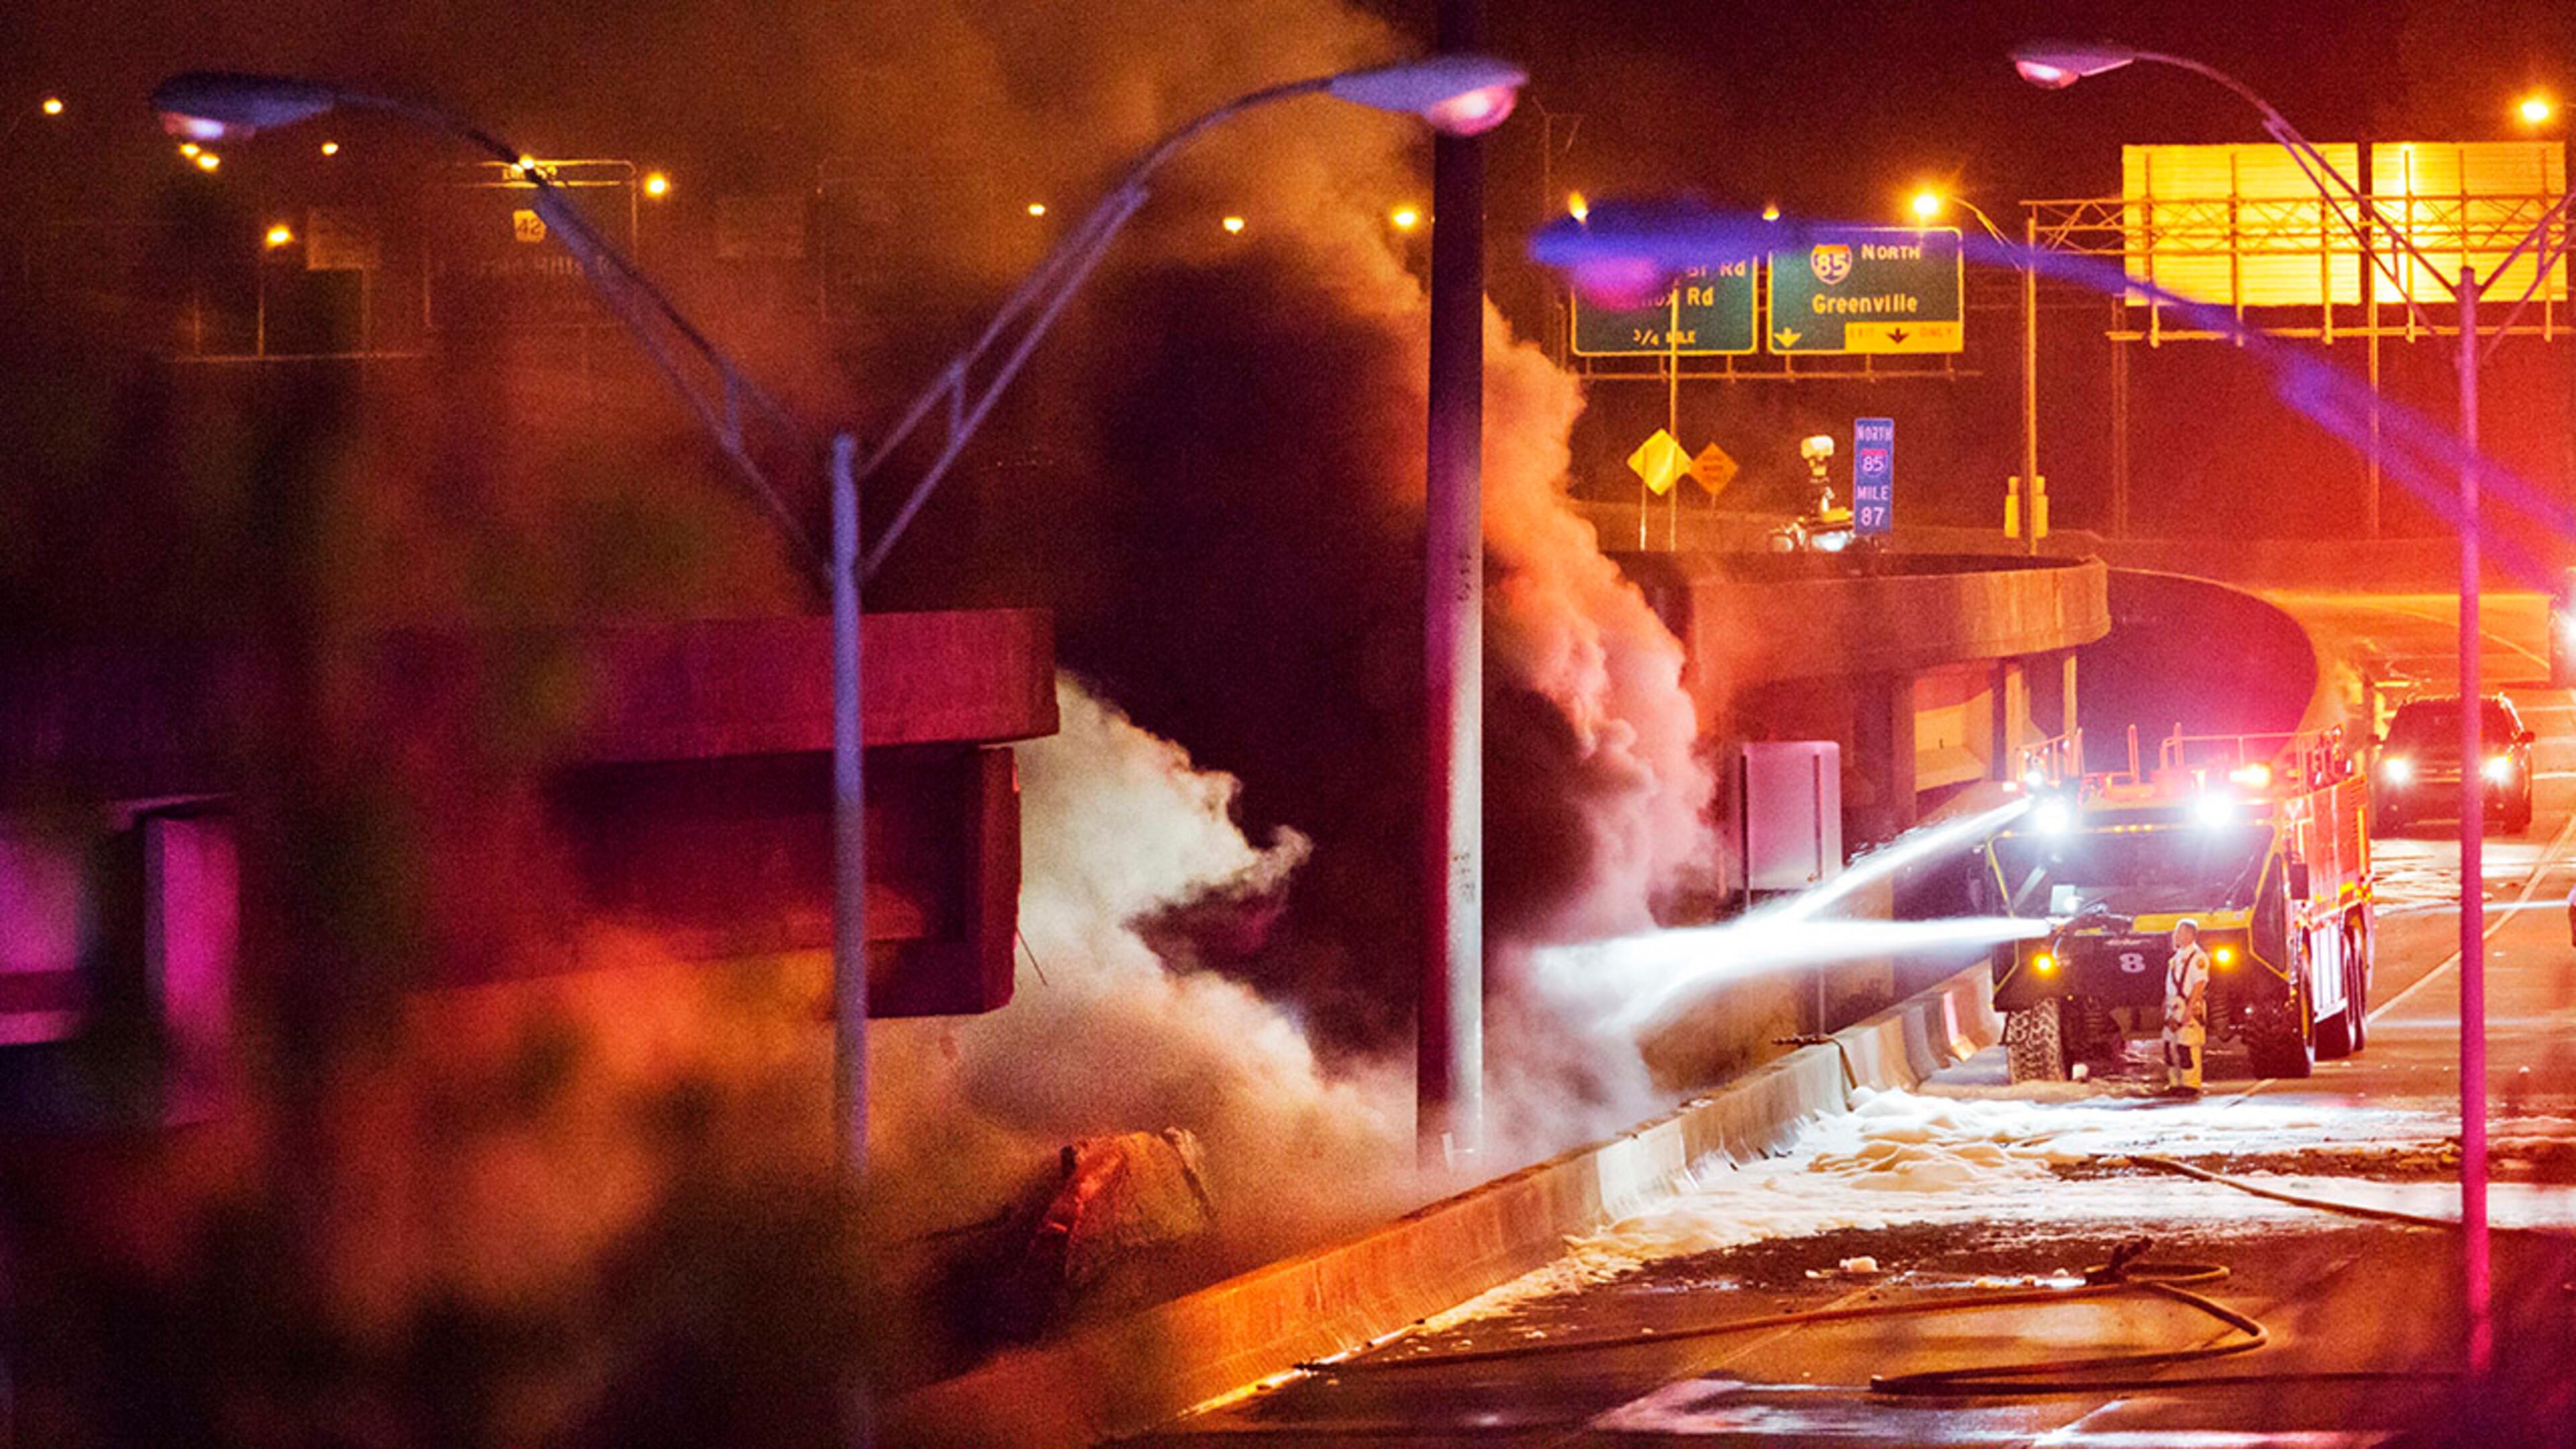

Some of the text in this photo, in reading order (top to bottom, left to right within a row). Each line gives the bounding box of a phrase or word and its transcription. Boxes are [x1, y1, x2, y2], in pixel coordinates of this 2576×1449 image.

[517, 219, 541, 235] 42
[1817, 244, 1921, 276] 85 NORTH
[1687, 286, 1713, 306] Rd
[1813, 293, 1917, 314] Greenville
[1856, 425, 1892, 441] NORTH
[1862, 455, 1884, 472] 85
[1857, 485, 1889, 500] MILE
[1861, 506, 1885, 526] 87
[2119, 953, 2145, 973] 8
